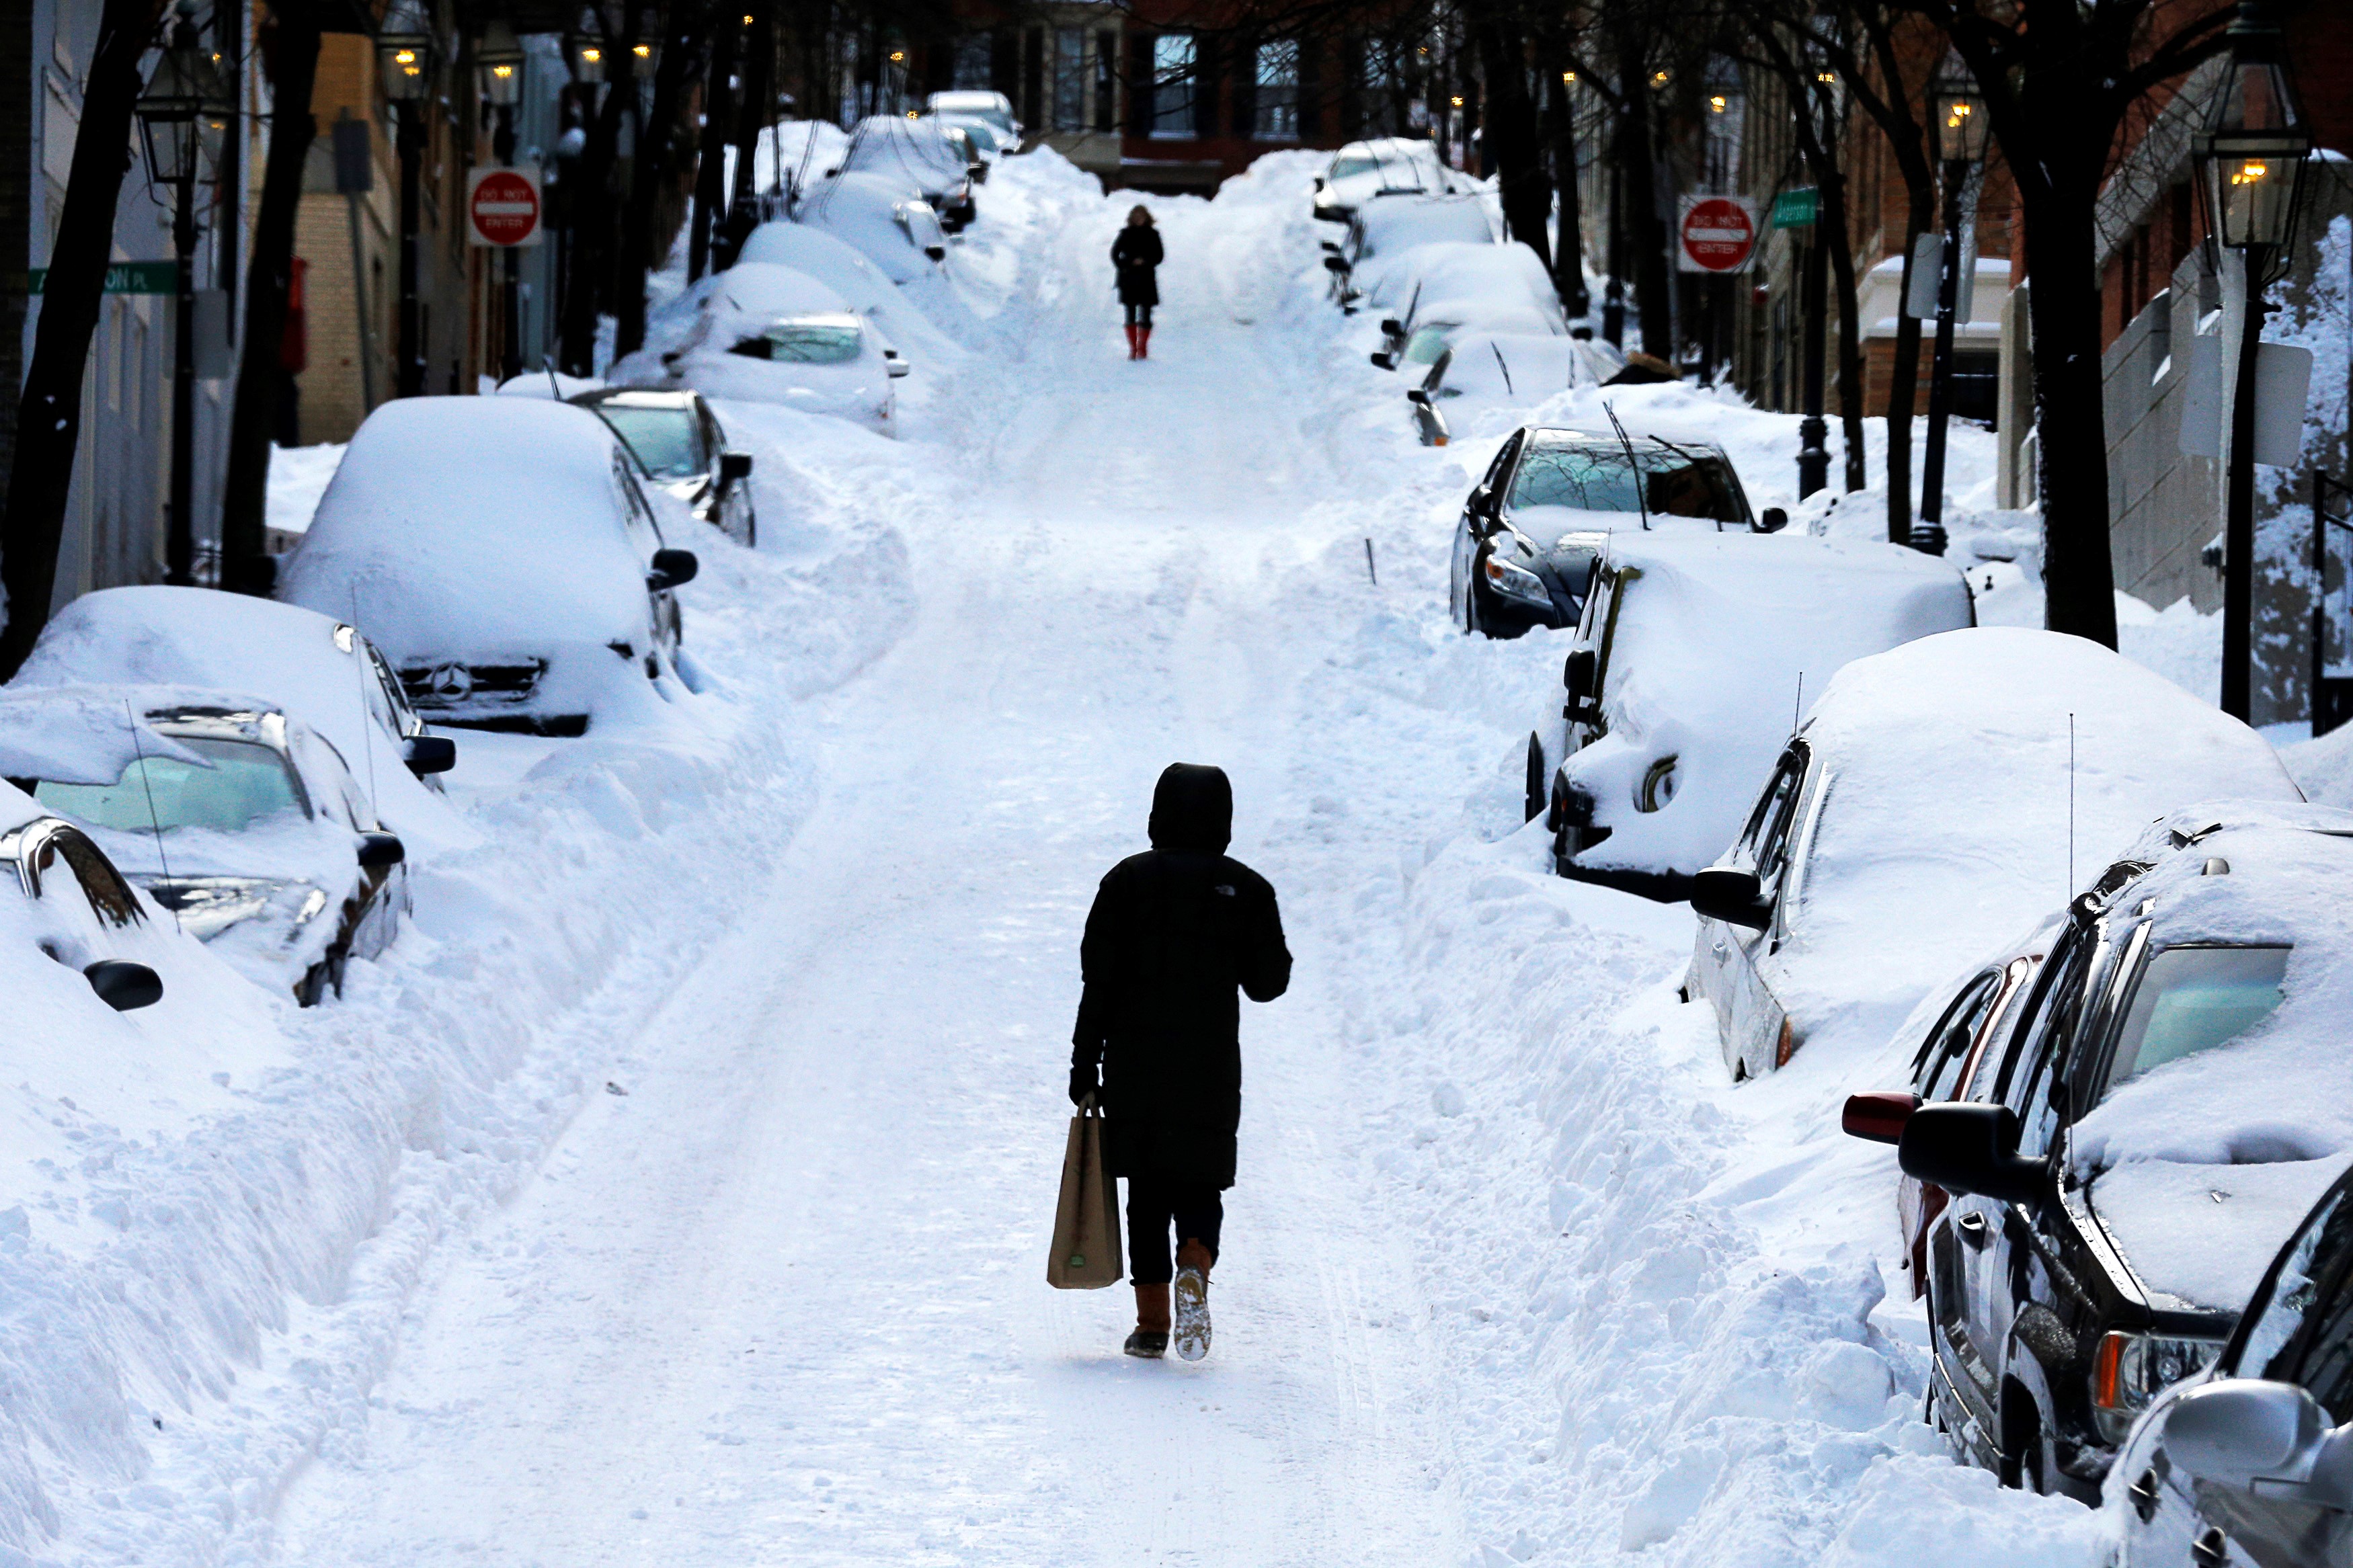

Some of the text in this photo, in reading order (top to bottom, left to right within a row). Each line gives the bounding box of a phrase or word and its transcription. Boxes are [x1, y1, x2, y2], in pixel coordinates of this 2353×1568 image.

[481, 188, 528, 200] DO NOT
[486, 218, 523, 229] ENTER
[1693, 215, 1742, 226] DO NOT
[1696, 243, 1738, 253] ENTER
